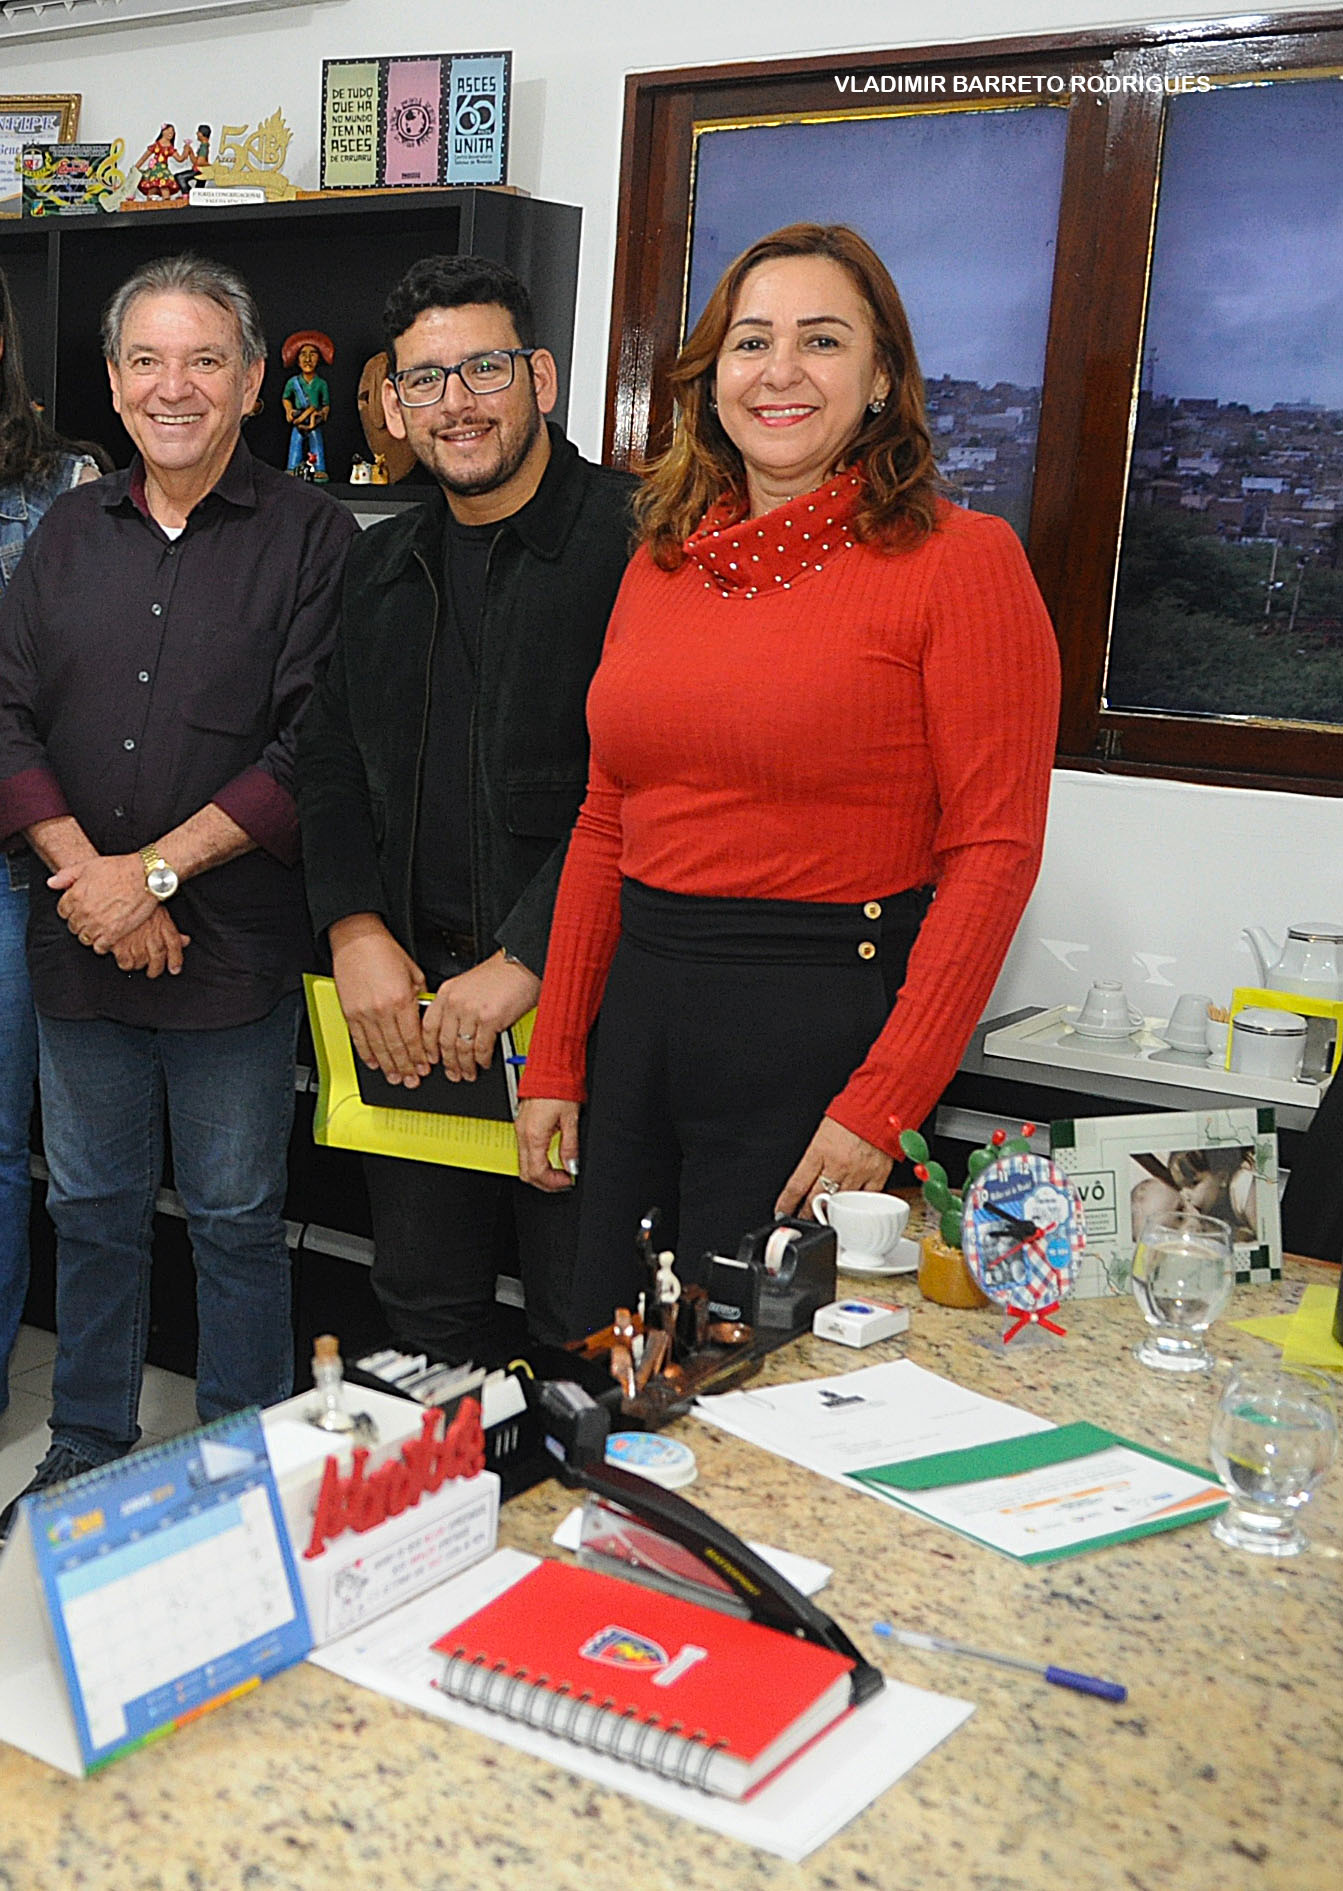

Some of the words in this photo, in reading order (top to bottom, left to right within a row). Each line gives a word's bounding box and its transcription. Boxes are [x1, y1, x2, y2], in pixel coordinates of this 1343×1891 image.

[457, 76, 496, 92] ASCES
[332, 89, 344, 99] DE
[348, 87, 374, 99] TUDO
[332, 101, 354, 113] QUE
[332, 115, 343, 123] NO
[345, 114, 373, 123] MUNDO
[456, 94, 496, 135] 60
[332, 125, 354, 137] TEM
[357, 125, 373, 136] NA
[331, 138, 372, 152] ASCES
[454, 138, 494, 153] UNITA
[1077, 1179, 1105, 1202] VÔ
